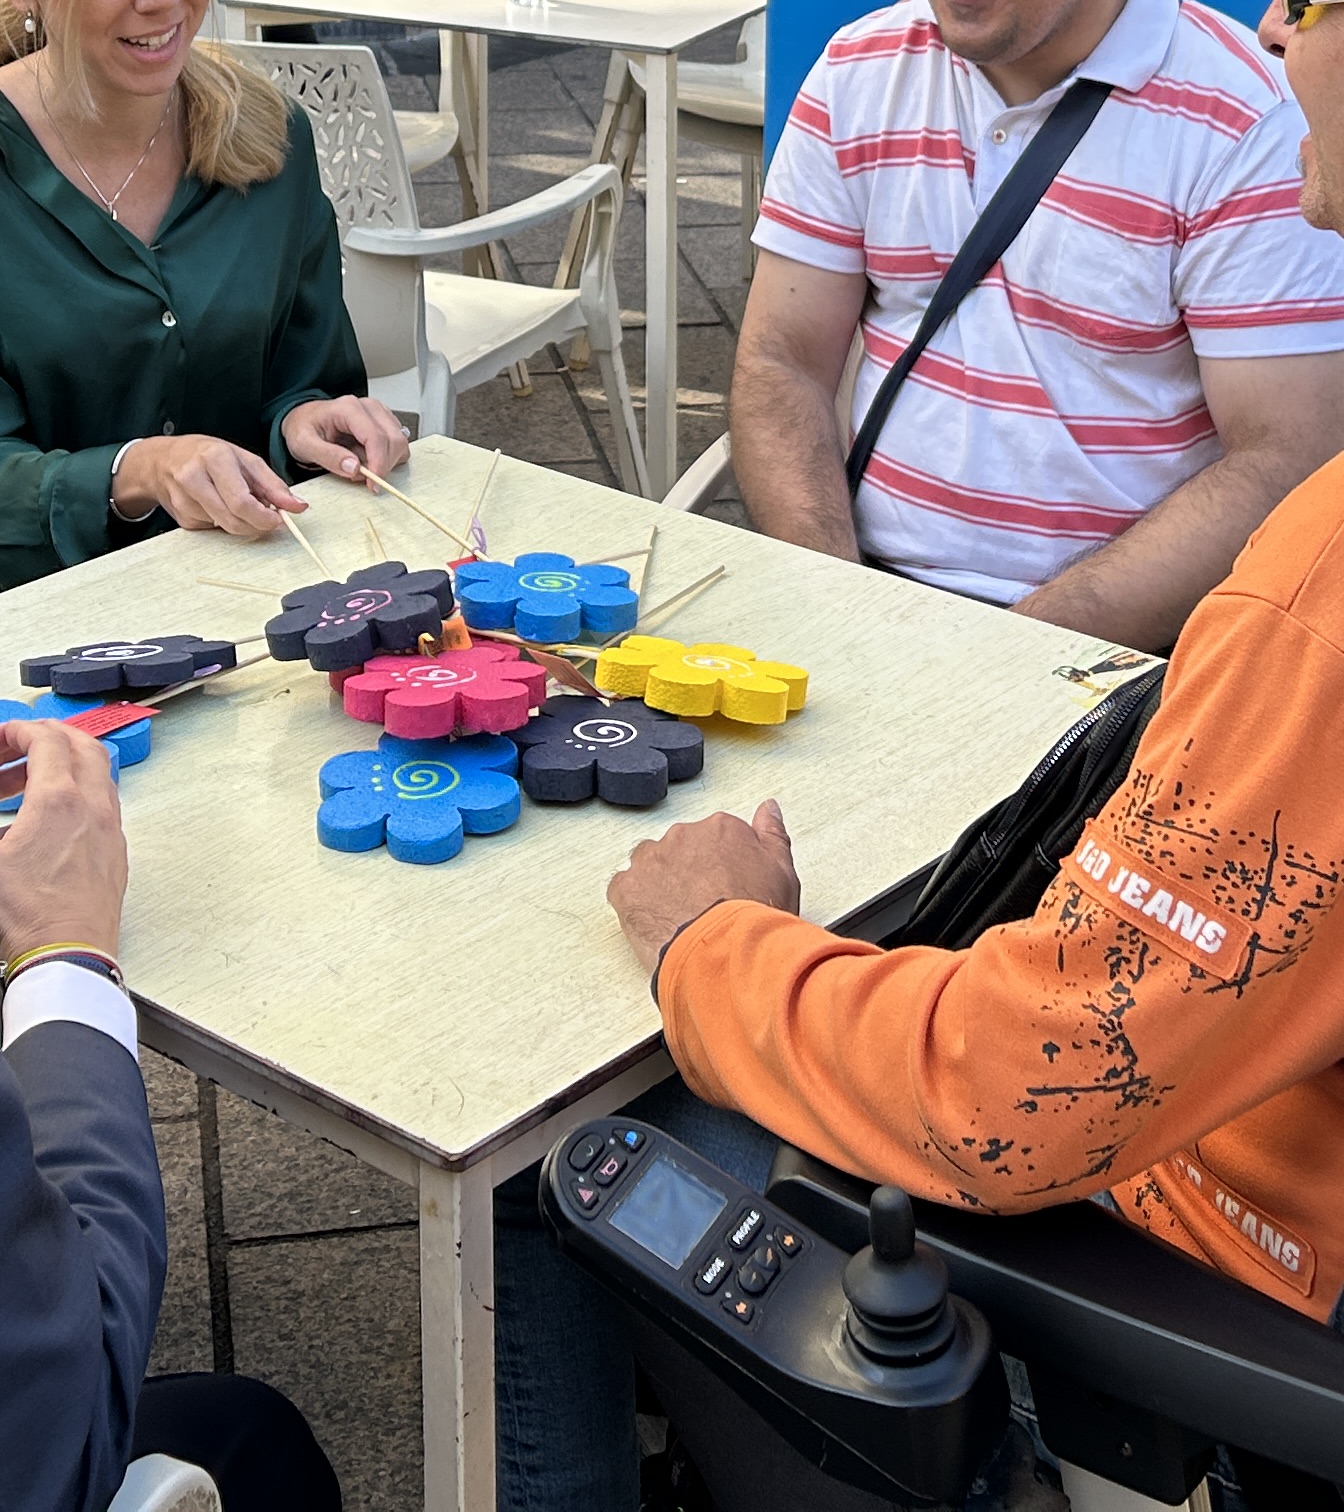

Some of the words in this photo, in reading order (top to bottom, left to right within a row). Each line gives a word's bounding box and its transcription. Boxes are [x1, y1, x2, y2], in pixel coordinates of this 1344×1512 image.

[1107, 865, 1228, 954] JEANS
[732, 1210, 760, 1245] PROFILE
[702, 1256, 725, 1284] MODE
